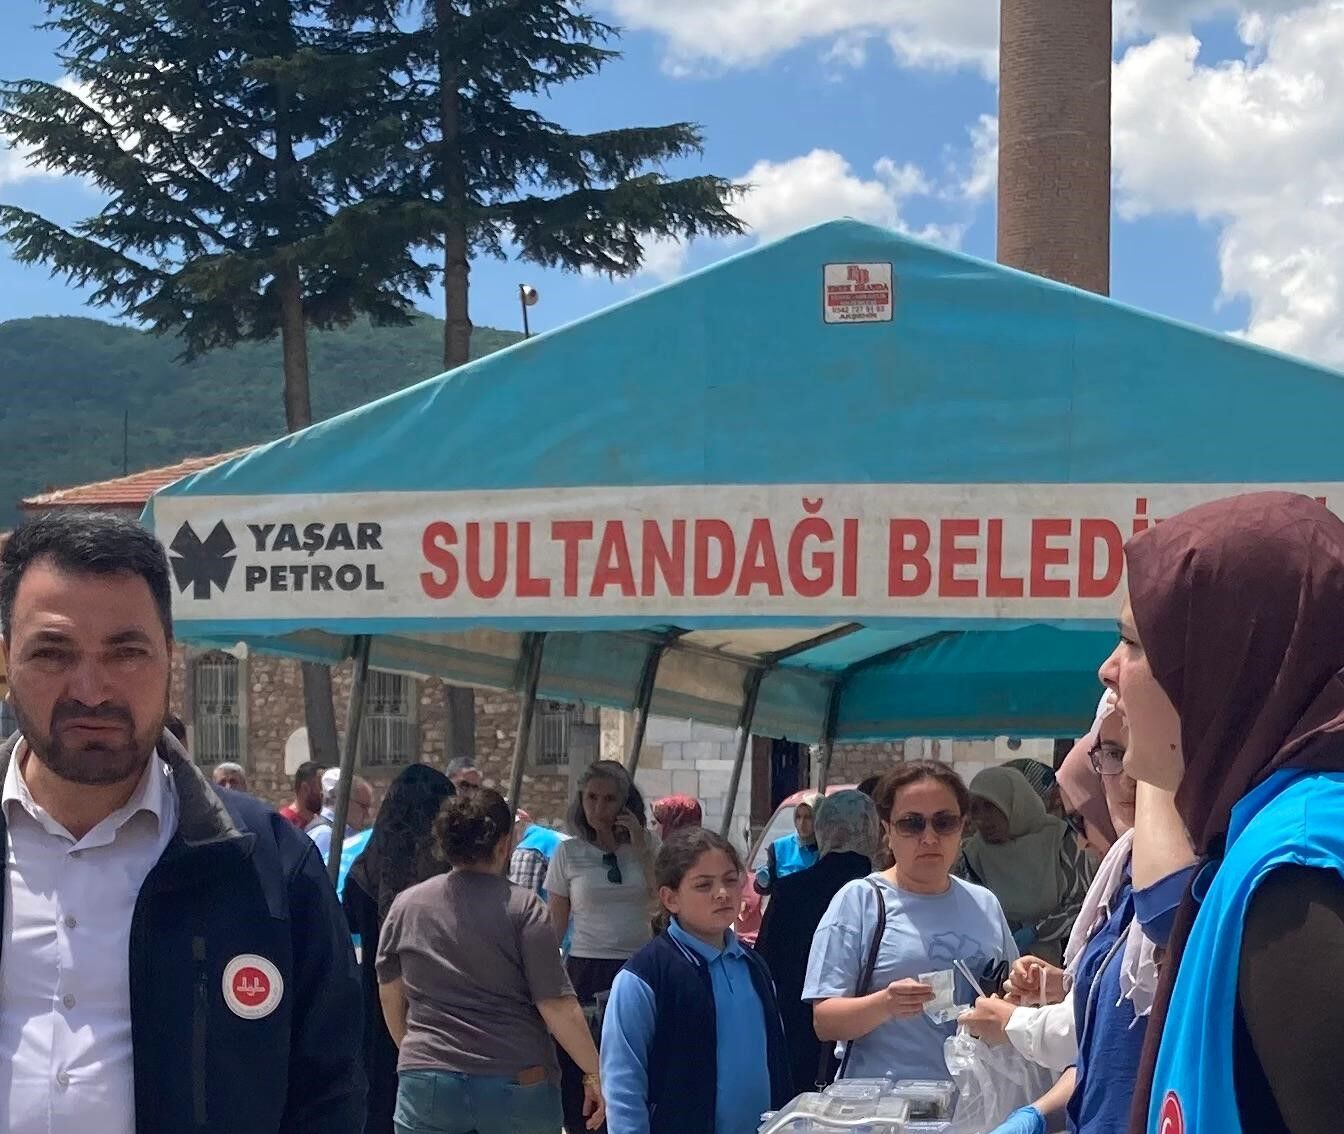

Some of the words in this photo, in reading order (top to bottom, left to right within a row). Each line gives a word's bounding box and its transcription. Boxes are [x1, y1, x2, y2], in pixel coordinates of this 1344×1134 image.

[247, 522, 383, 557] YAŞAR
[420, 497, 859, 599] SULTANDAĞI
[245, 564, 385, 592] PETROL
